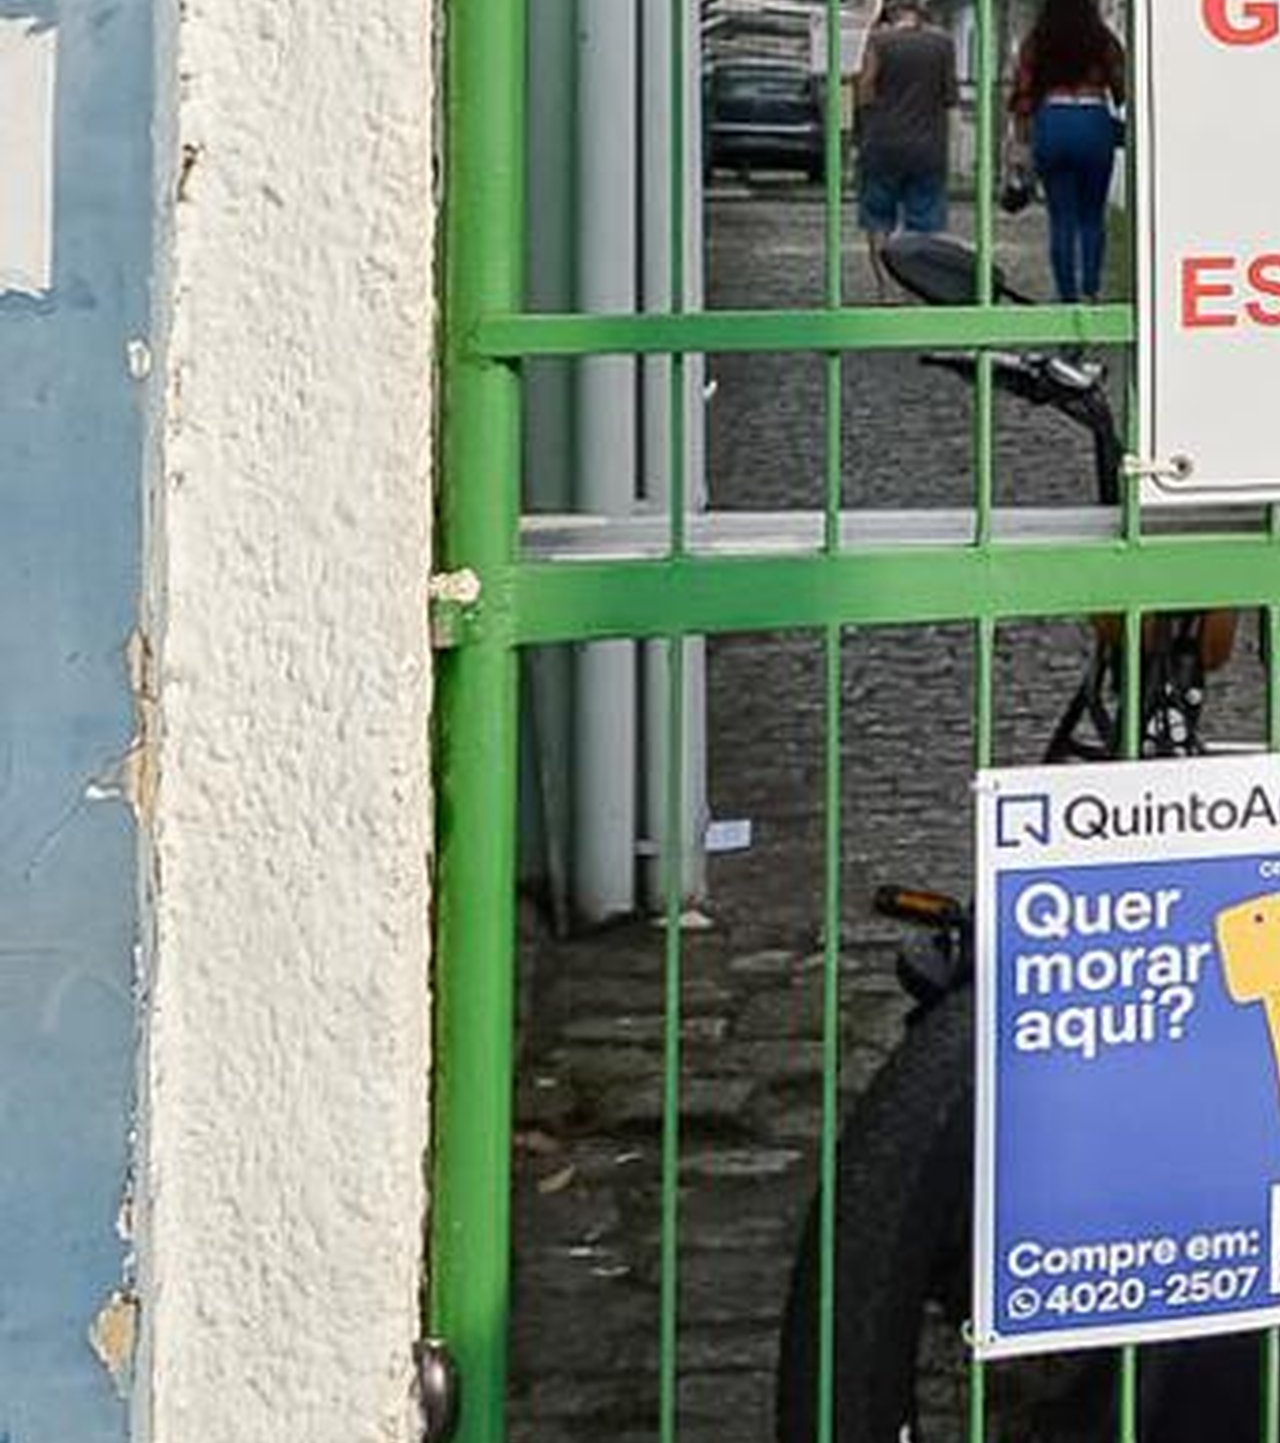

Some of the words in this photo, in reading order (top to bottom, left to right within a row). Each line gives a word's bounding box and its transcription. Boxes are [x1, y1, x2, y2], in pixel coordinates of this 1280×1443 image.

[1015, 882, 1181, 940] Quer
[1016, 942, 1212, 995] morar
[1014, 987, 1194, 1059] aqui?
[1008, 1238, 1178, 1277] Compre
[1186, 1229, 1260, 1262] em:
[1046, 1266, 1259, 1315] 4020-2507
